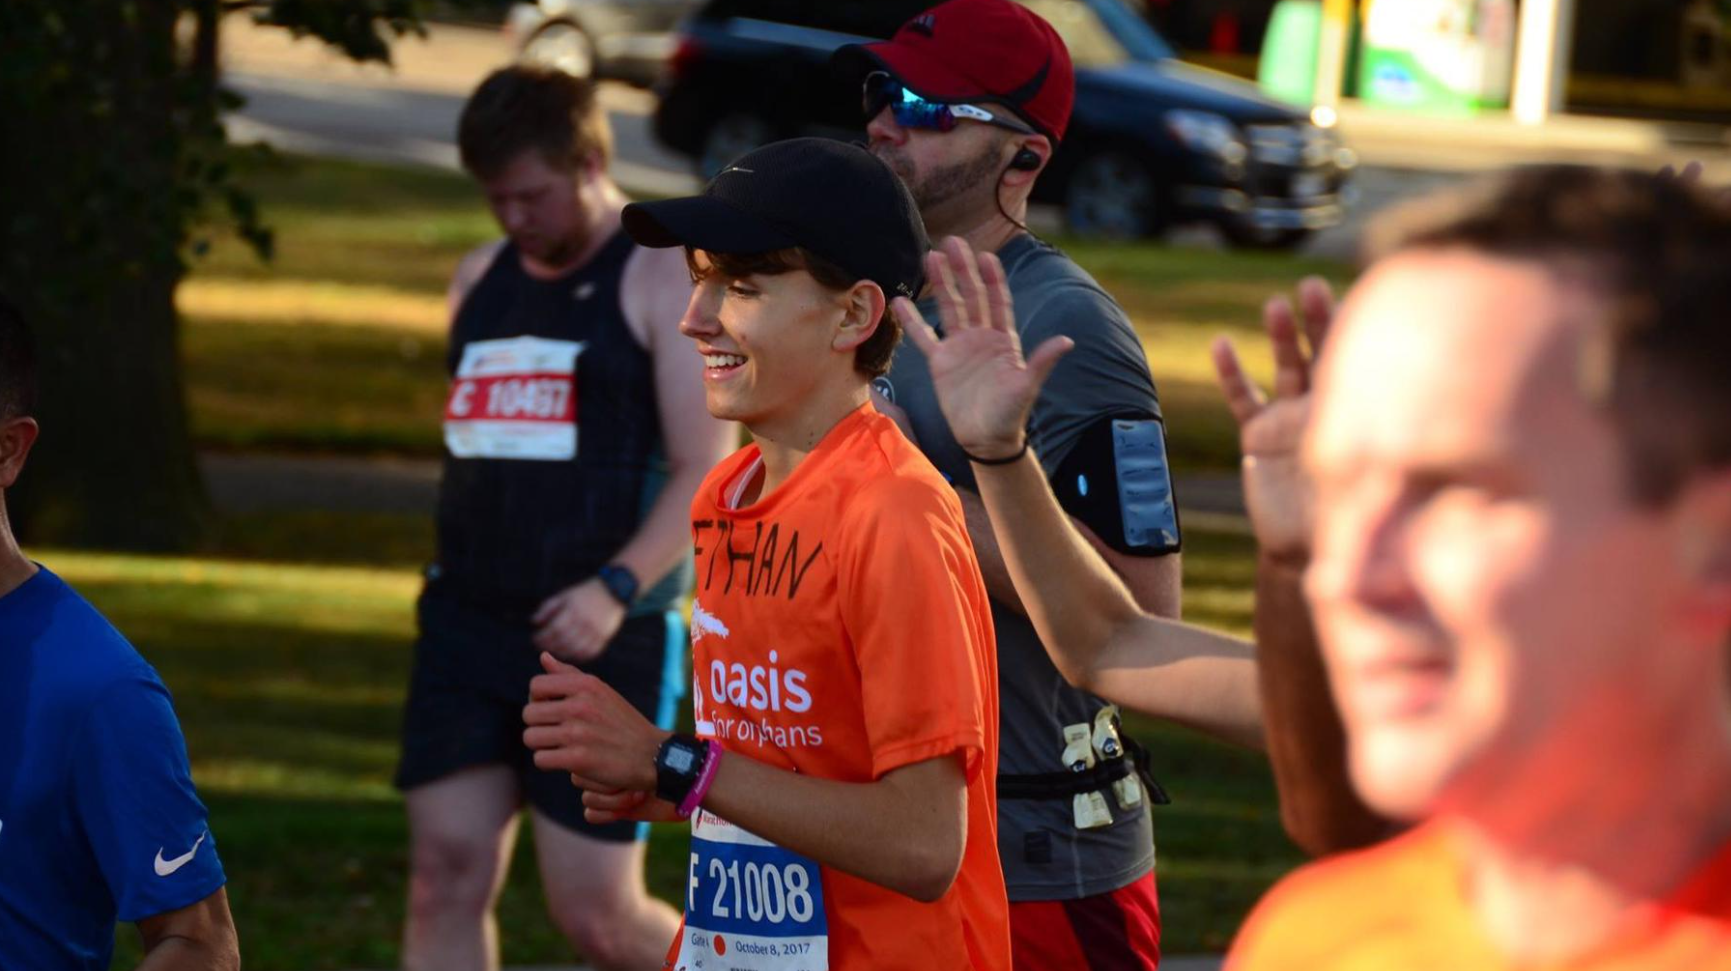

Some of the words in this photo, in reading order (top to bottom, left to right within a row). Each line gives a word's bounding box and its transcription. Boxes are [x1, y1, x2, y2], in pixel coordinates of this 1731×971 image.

[451, 380, 476, 417] C
[711, 650, 812, 713] oasis
[712, 710, 735, 739] for
[737, 718, 823, 748] orphans
[689, 852, 699, 911] F
[709, 857, 814, 923] 21008
[735, 941, 768, 955] October
[770, 944, 781, 957] 8,
[783, 943, 811, 956] 2017
